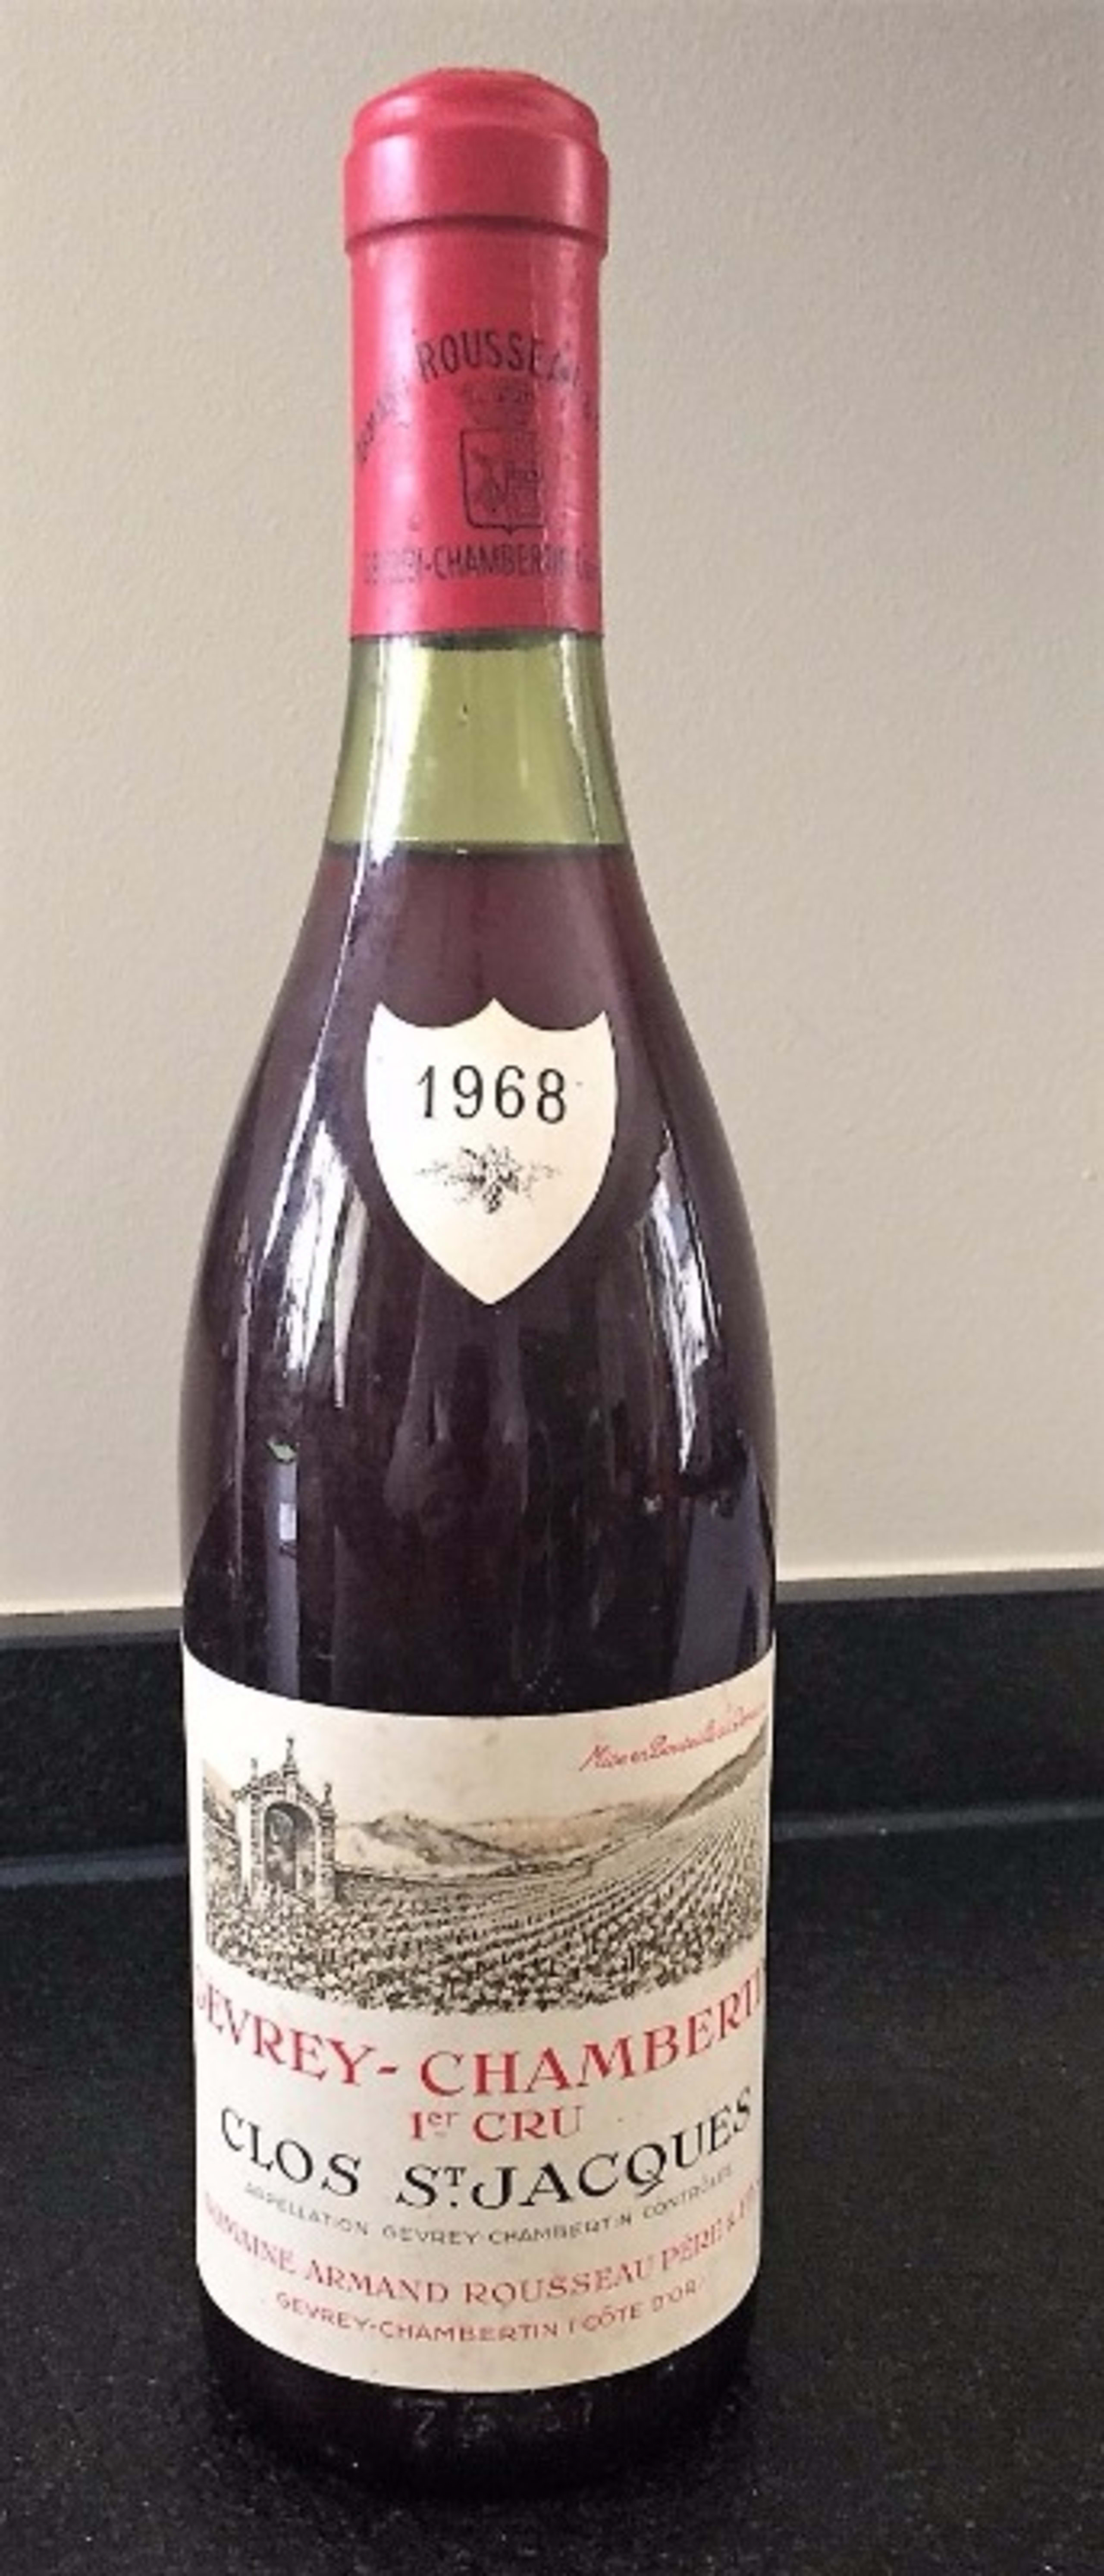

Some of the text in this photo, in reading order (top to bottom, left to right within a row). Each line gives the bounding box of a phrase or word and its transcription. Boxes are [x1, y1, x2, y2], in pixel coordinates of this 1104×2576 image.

[417, 1064, 567, 1124] 1968
[420, 1961, 766, 2097] CHAMBERTI
[221, 2105, 361, 2197] CLOS
[474, 2104, 584, 2142] CRU
[304, 2259, 449, 2305] ARMAND
[465, 2254, 654, 2305] ROUSSEAU
